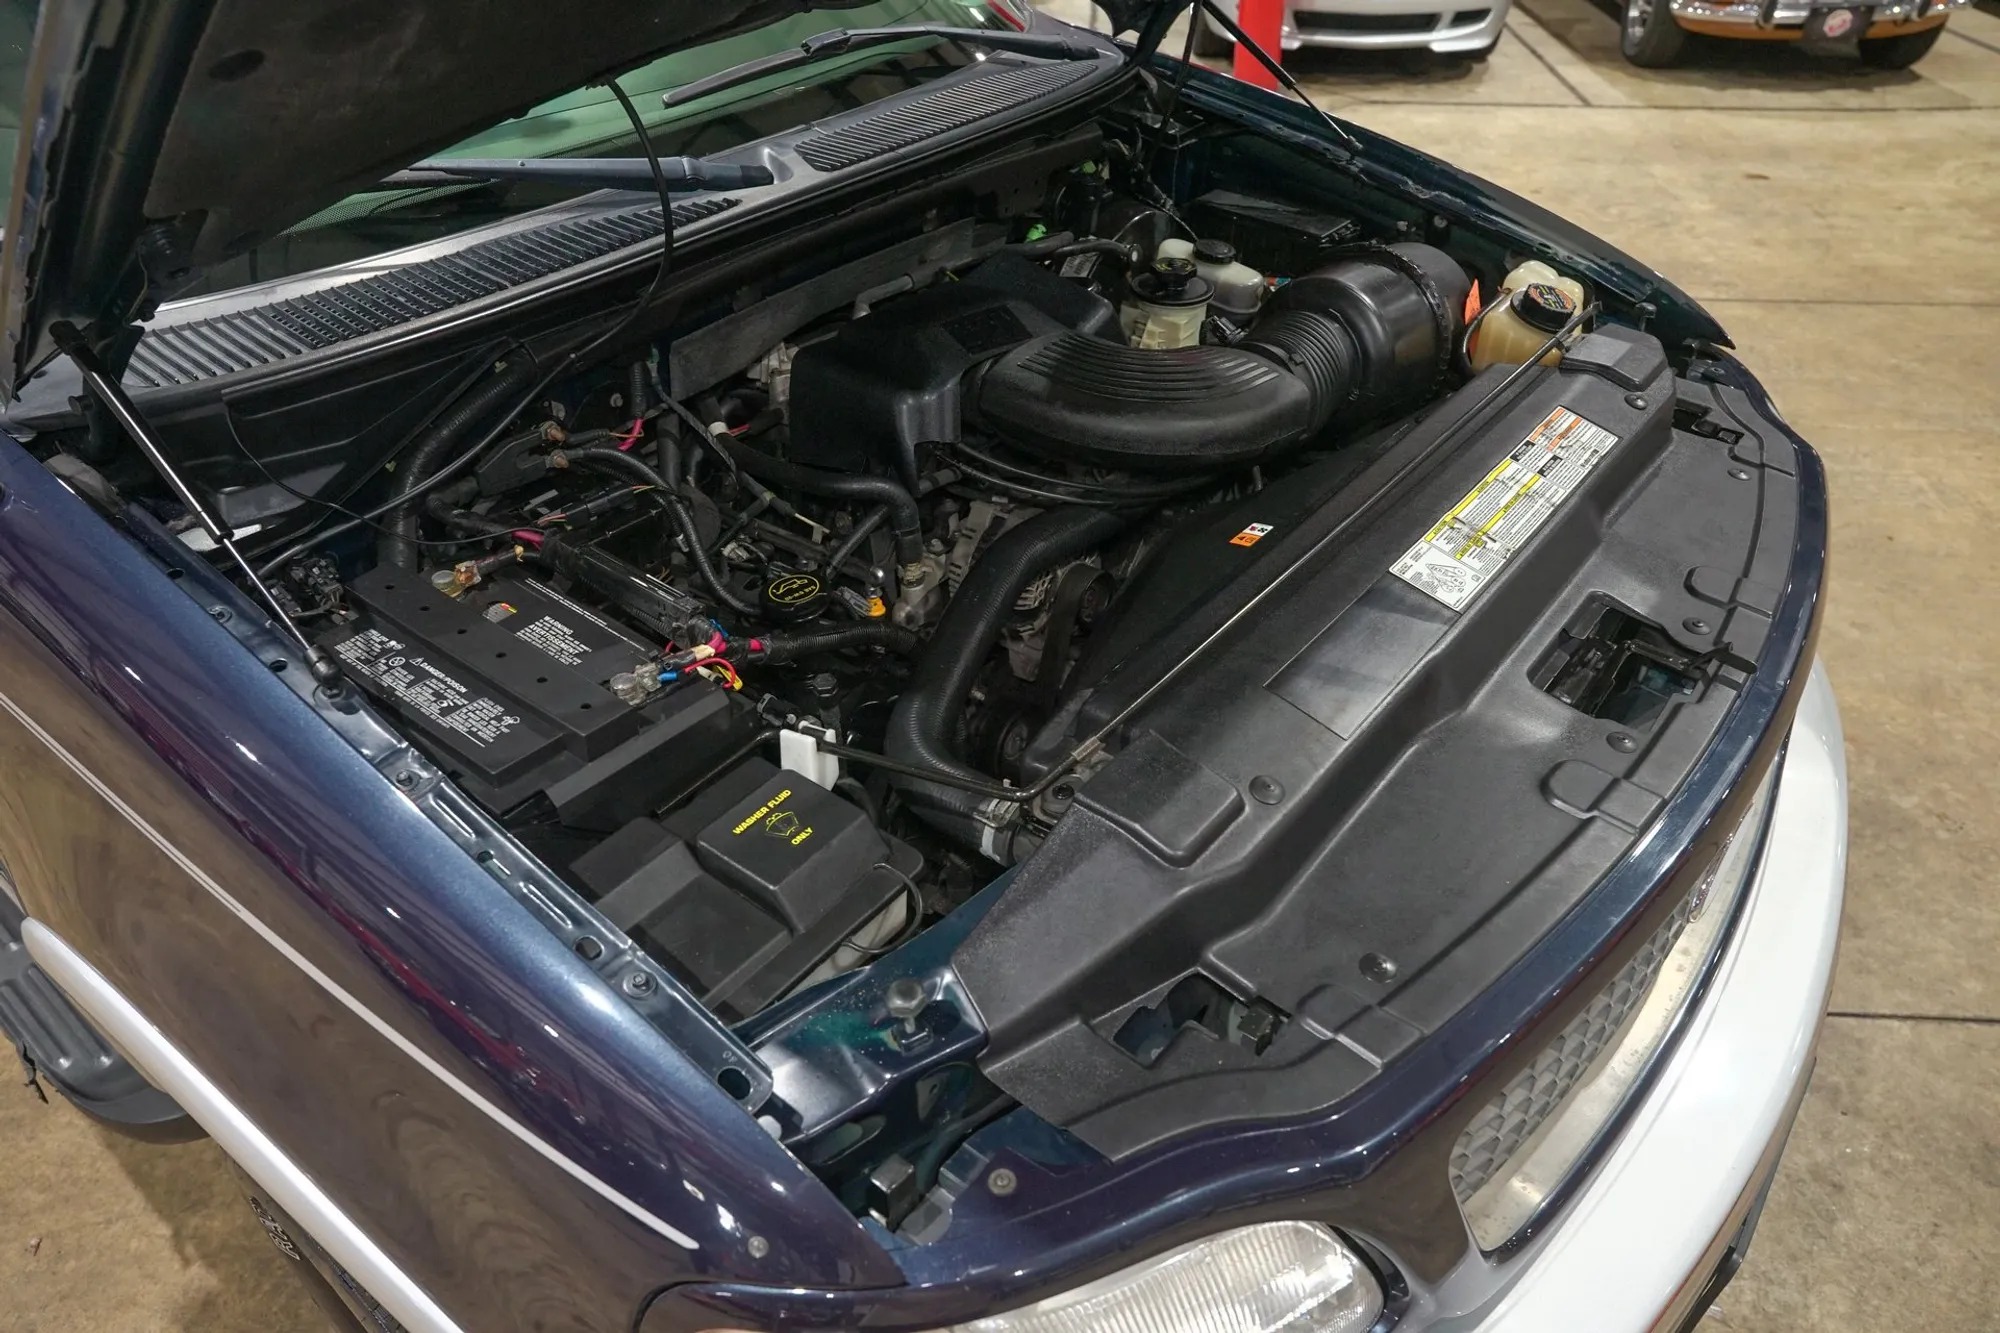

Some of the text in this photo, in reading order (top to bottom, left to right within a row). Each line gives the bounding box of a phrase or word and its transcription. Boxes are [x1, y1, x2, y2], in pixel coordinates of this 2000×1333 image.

[543, 616, 574, 635] WARNING
[528, 624, 579, 655] AVERTISSEMENT
[732, 789, 792, 835] WASHER FLUID
[791, 826, 814, 846] ONLY
